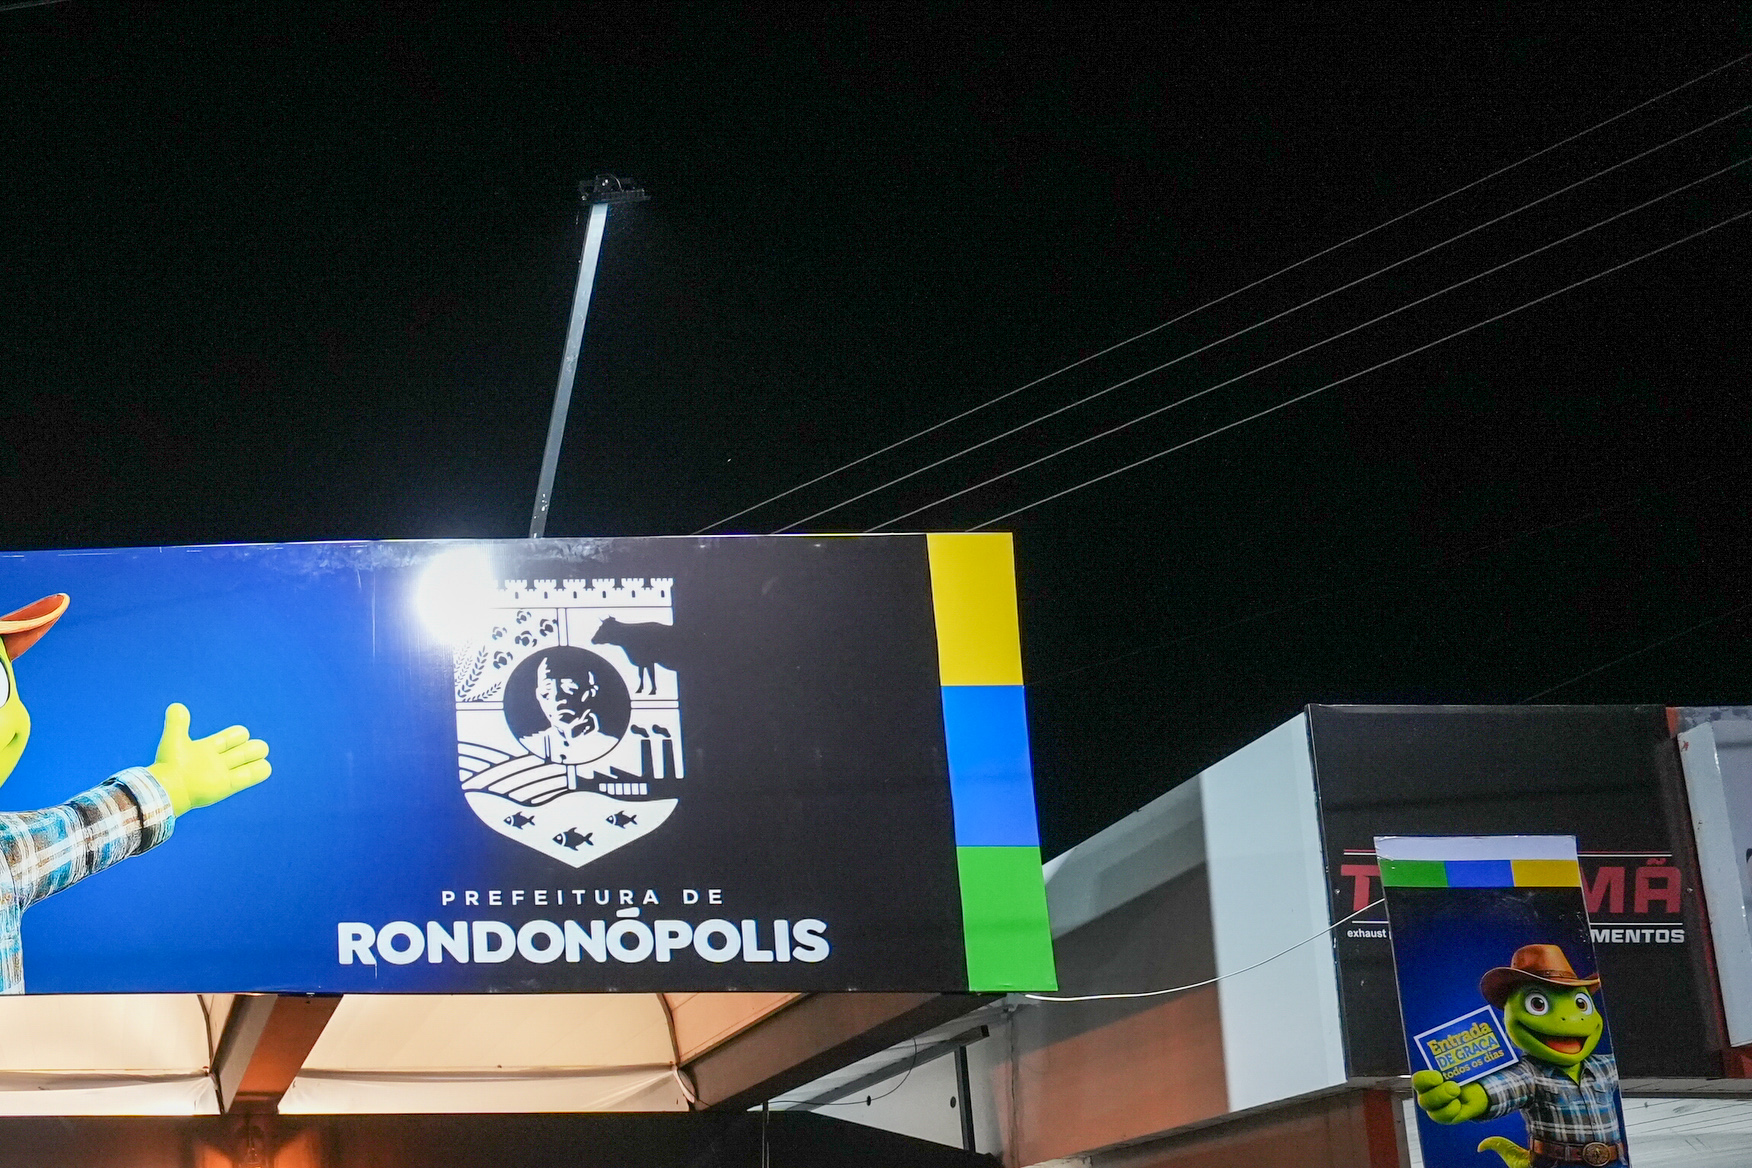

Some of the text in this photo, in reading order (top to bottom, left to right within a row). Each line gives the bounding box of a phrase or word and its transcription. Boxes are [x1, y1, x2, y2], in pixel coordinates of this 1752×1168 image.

[441, 888, 724, 907] PREFEITURA DE
[337, 906, 831, 966] RONDONÓPOLIS
[1347, 928, 1387, 938] exhaust
[1426, 1021, 1493, 1055] Entrada
[1435, 1052, 1455, 1069] DE
[1442, 1048, 1505, 1080] todos os dias
